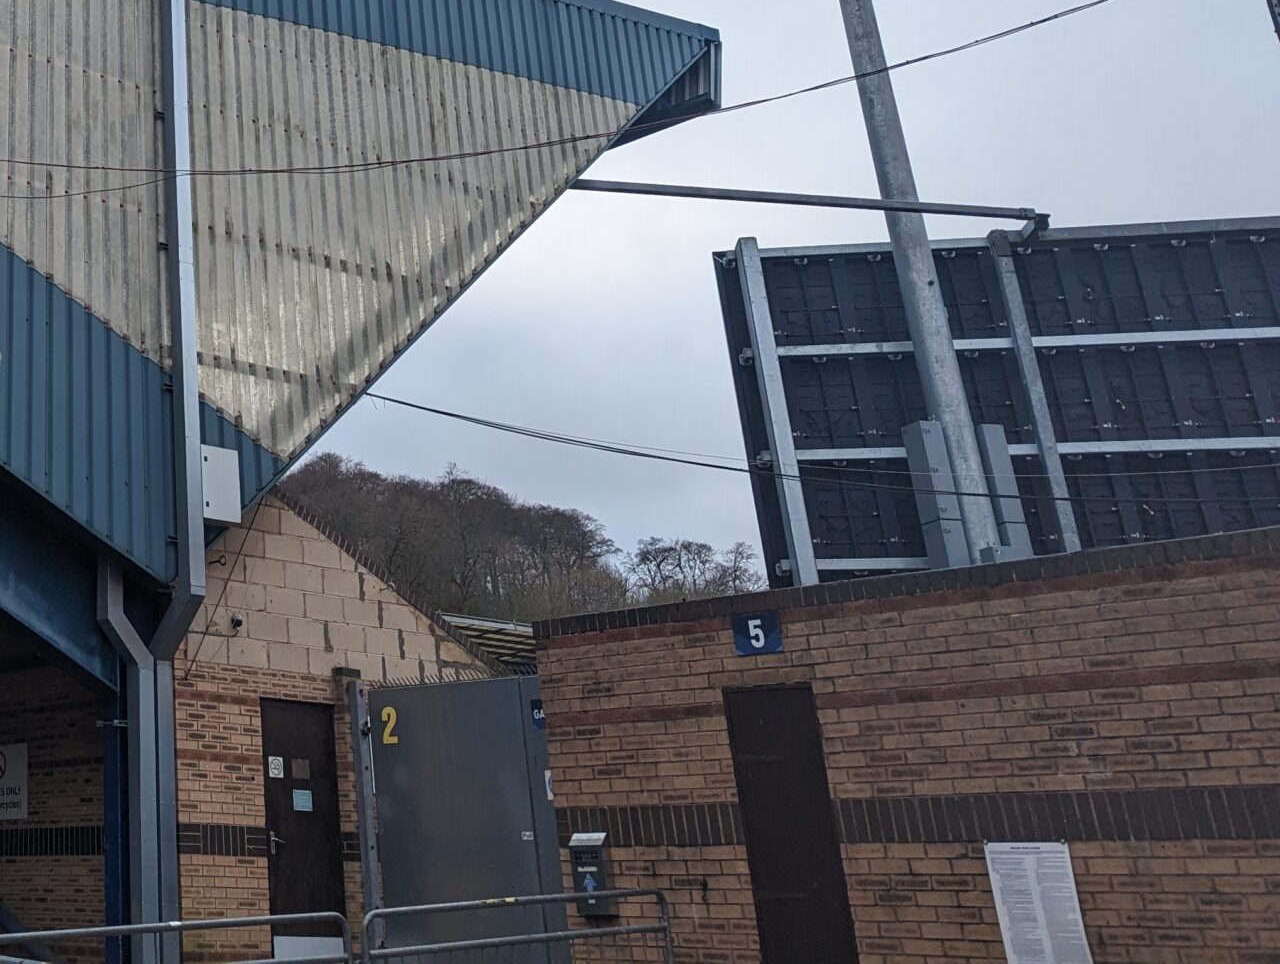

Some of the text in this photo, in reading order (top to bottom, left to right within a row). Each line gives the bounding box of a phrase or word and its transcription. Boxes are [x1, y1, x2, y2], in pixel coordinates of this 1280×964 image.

[747, 619, 765, 648] 5
[381, 706, 399, 744] 2
[5, 786, 21, 796] ONLY
